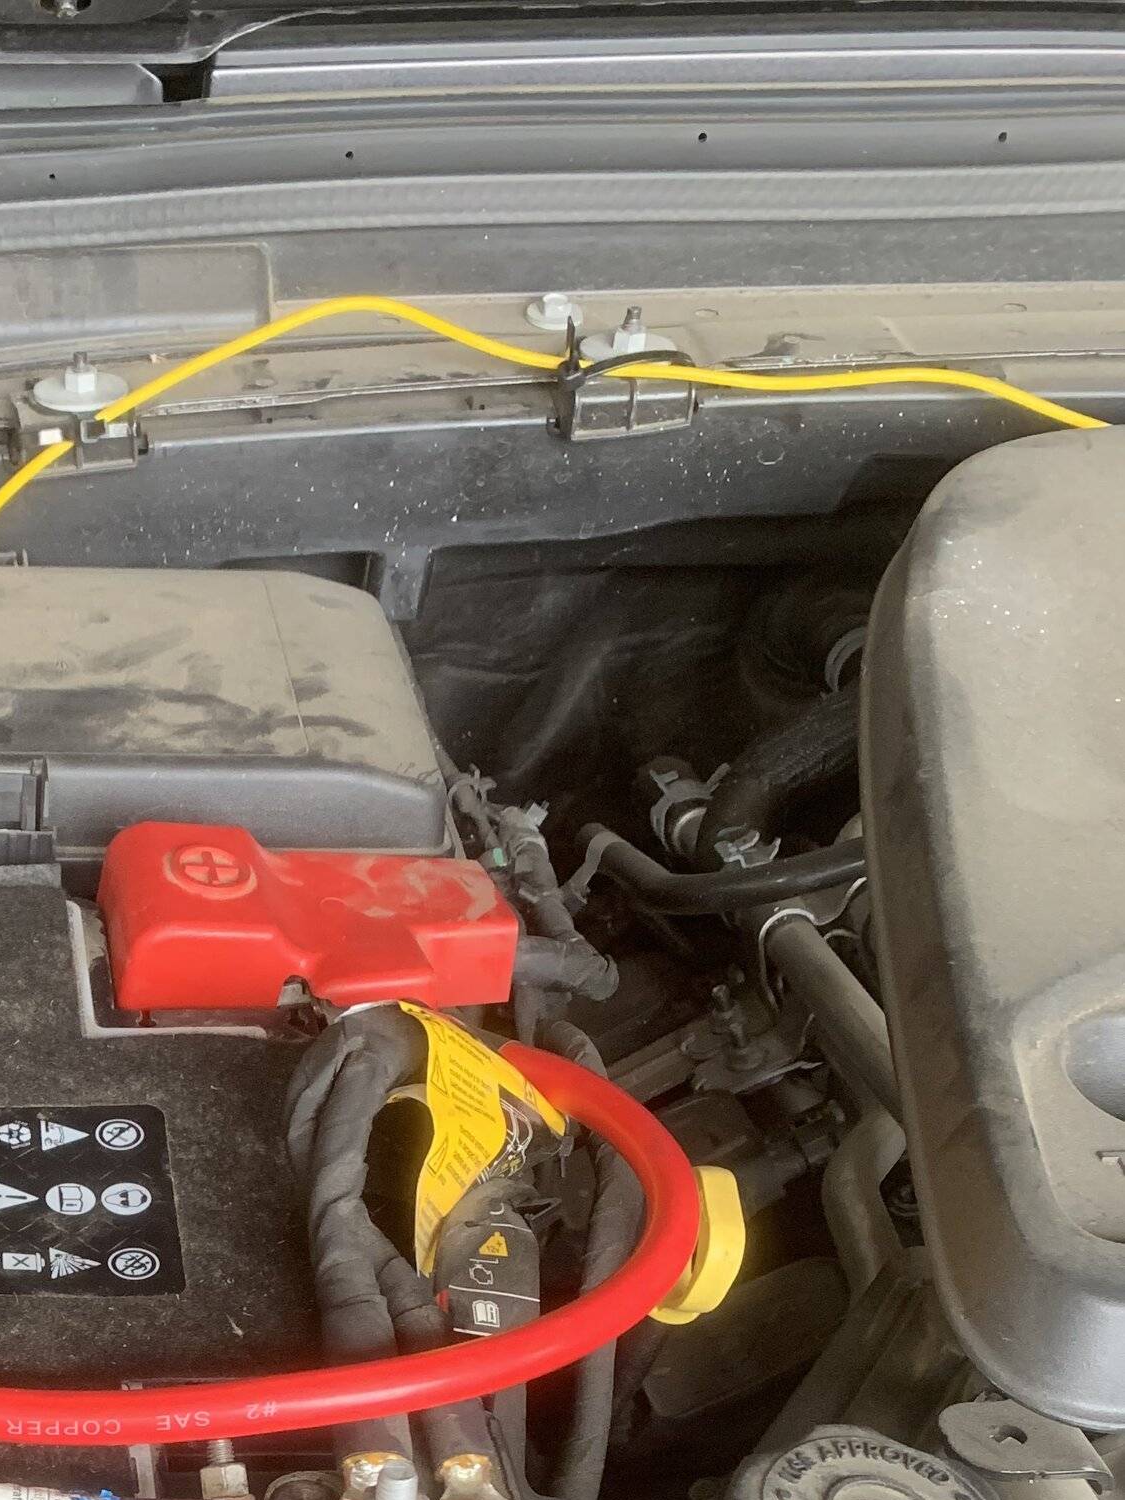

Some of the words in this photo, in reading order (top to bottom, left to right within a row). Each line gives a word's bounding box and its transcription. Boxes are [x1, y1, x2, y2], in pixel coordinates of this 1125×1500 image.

[246, 1401, 278, 1420] #2
[6, 1418, 121, 1436] COPPER
[155, 1411, 211, 1431] SAE
[818, 1440, 950, 1486] APPROVED
